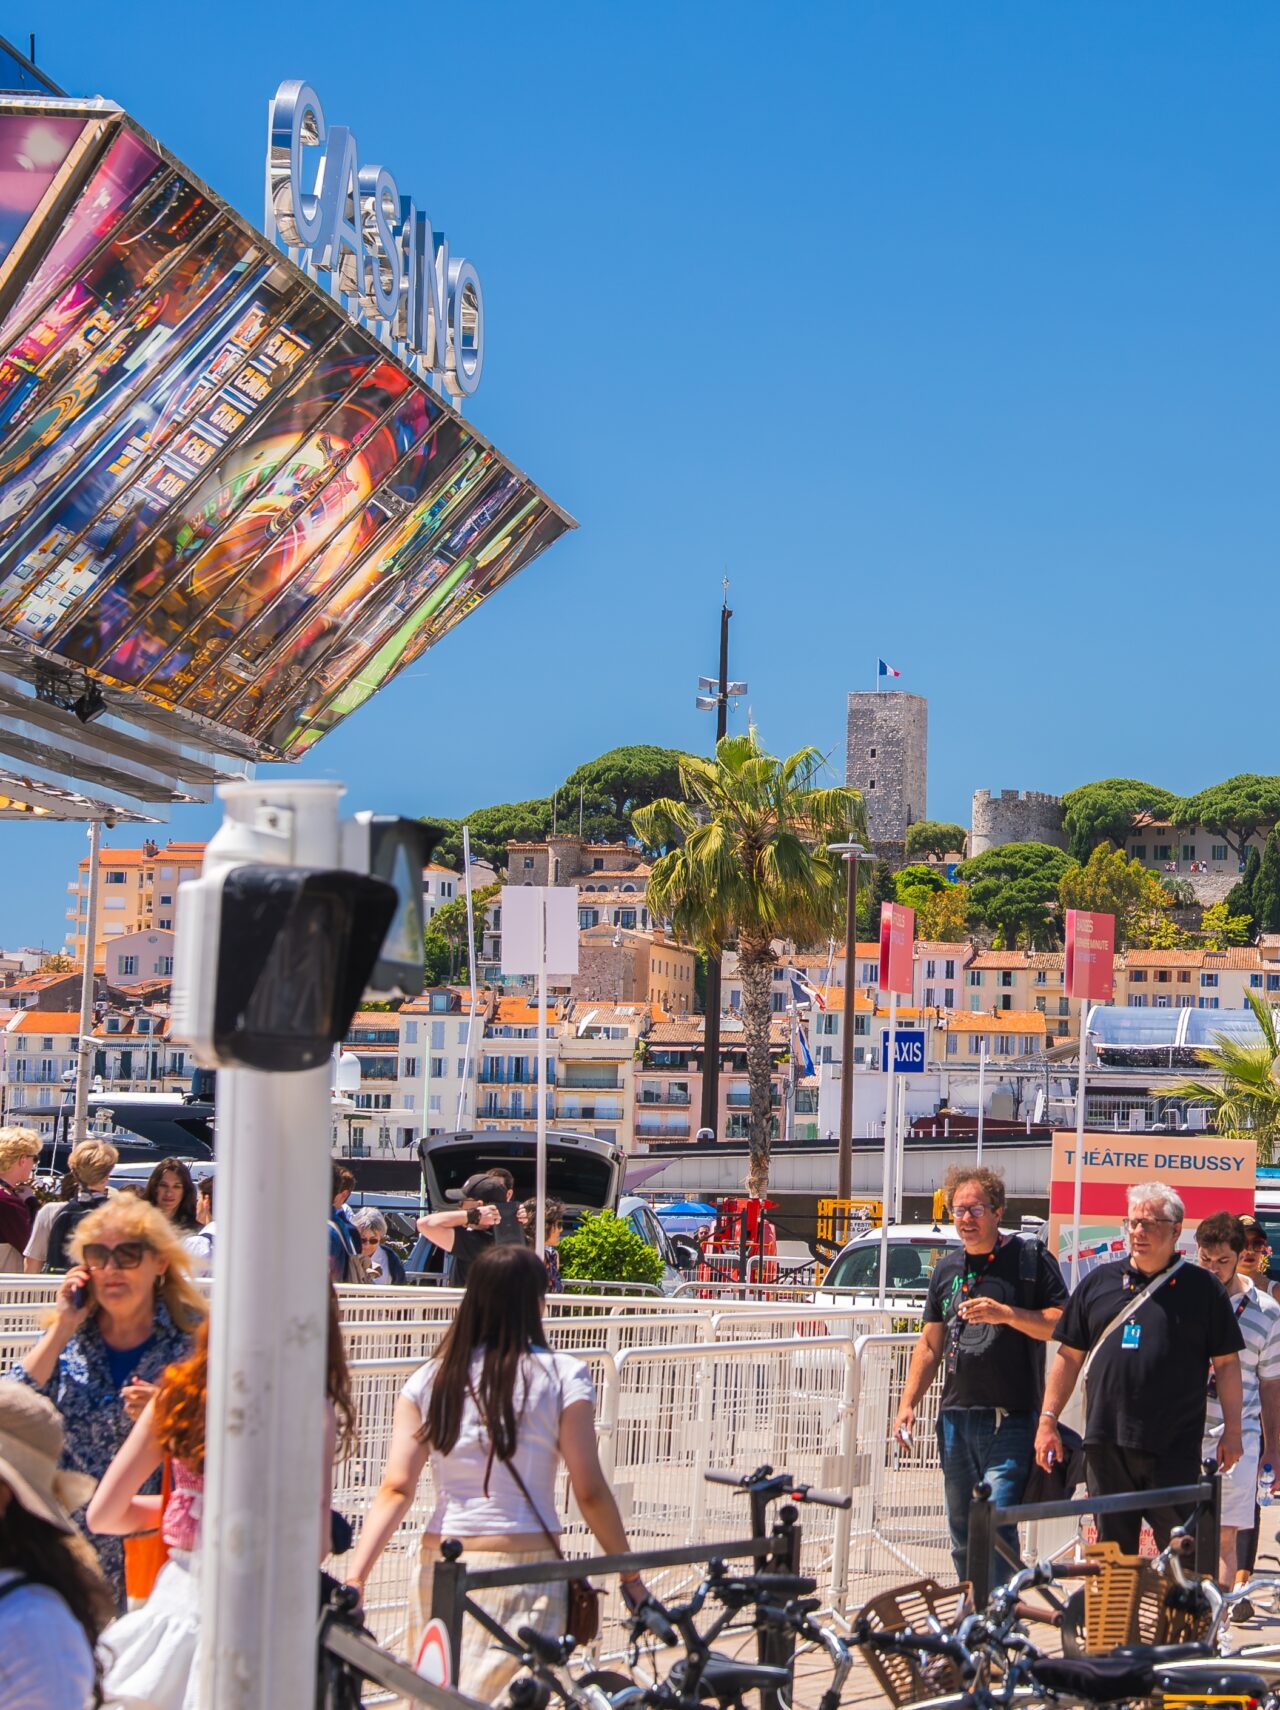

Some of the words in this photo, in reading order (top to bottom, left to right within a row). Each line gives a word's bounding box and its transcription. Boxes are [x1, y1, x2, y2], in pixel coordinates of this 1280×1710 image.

[270, 79, 483, 398] CASINO
[885, 1041, 922, 1062] AXIS
[1064, 1148, 1149, 1168] THÉÂTRE
[1154, 1154, 1245, 1171] DEBUSSY
